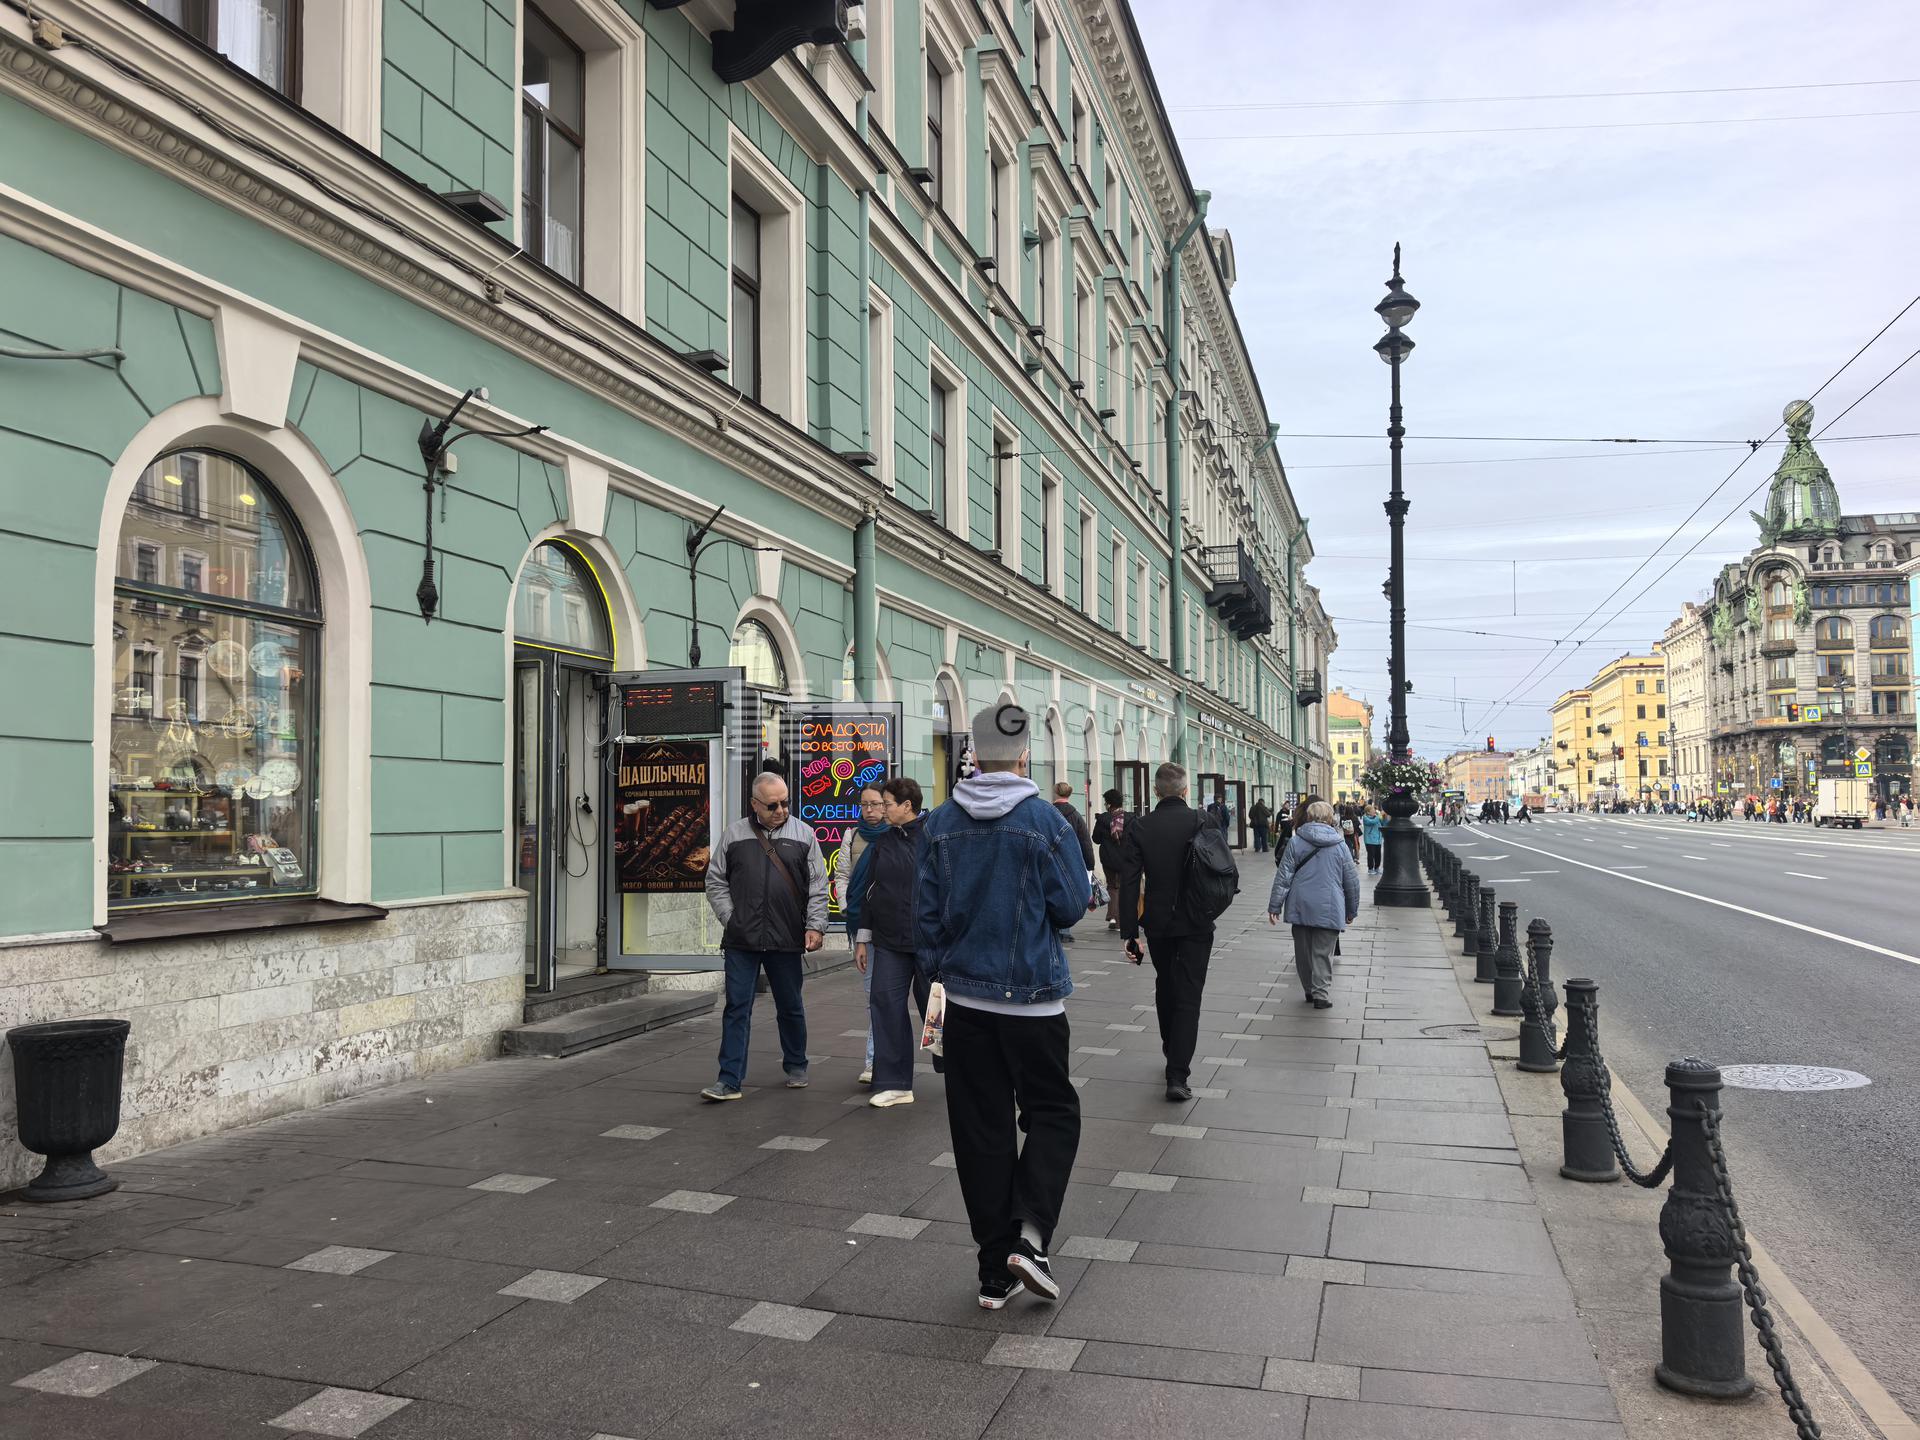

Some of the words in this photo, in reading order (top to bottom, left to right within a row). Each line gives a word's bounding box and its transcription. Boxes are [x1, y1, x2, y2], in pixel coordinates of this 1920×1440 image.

[802, 722, 886, 737] СЛАДОСТИ
[801, 741, 820, 752] СО
[821, 741, 856, 752] ВСЕГО
[857, 741, 884, 752] МИРА
[618, 763, 706, 788] ШАШЛЫЧНАЯ
[648, 789, 674, 797] ШАШЛЫК
[675, 789, 684, 797] НА
[802, 804, 862, 819] СУВЕНИ
[622, 882, 642, 890] МЯСО
[647, 881, 673, 889] ОВОЩИ
[679, 881, 704, 889] ЛАВАШ
